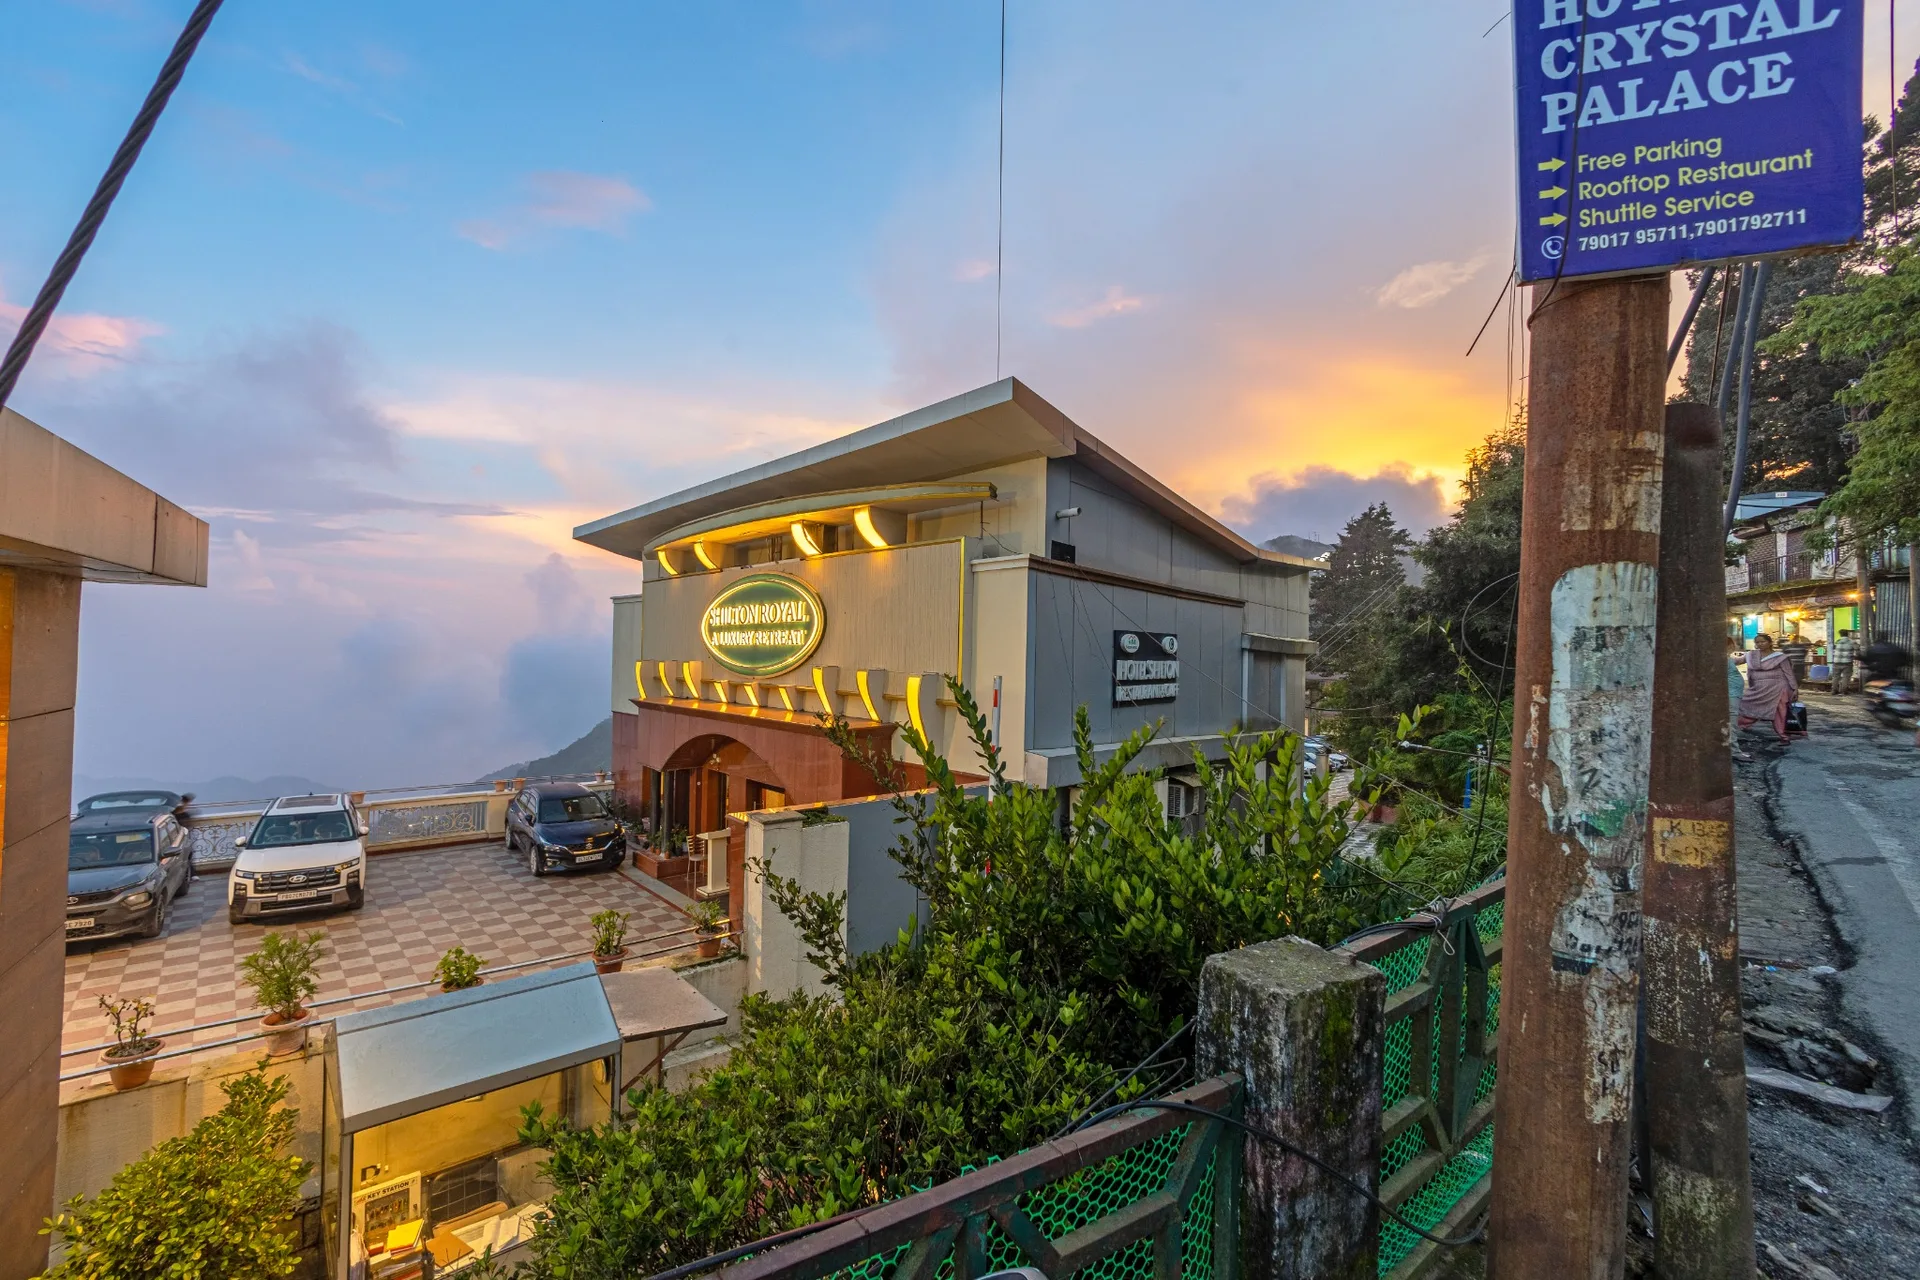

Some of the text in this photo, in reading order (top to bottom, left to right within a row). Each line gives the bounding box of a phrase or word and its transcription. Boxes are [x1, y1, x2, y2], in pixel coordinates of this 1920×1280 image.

[1541, 0, 1841, 79] CRYSTAL
[1541, 52, 1795, 134] PALACE
[1578, 137, 1722, 173] Free Parking
[1578, 148, 1813, 200] Rooftop Restaurant
[1579, 187, 1754, 227] Shuttle Service
[1579, 231, 1629, 252] 79017
[760, 602, 809, 622] ROYAL
[368, 1191, 381, 1200] KEY
[382, 1181, 410, 1194] STATION
